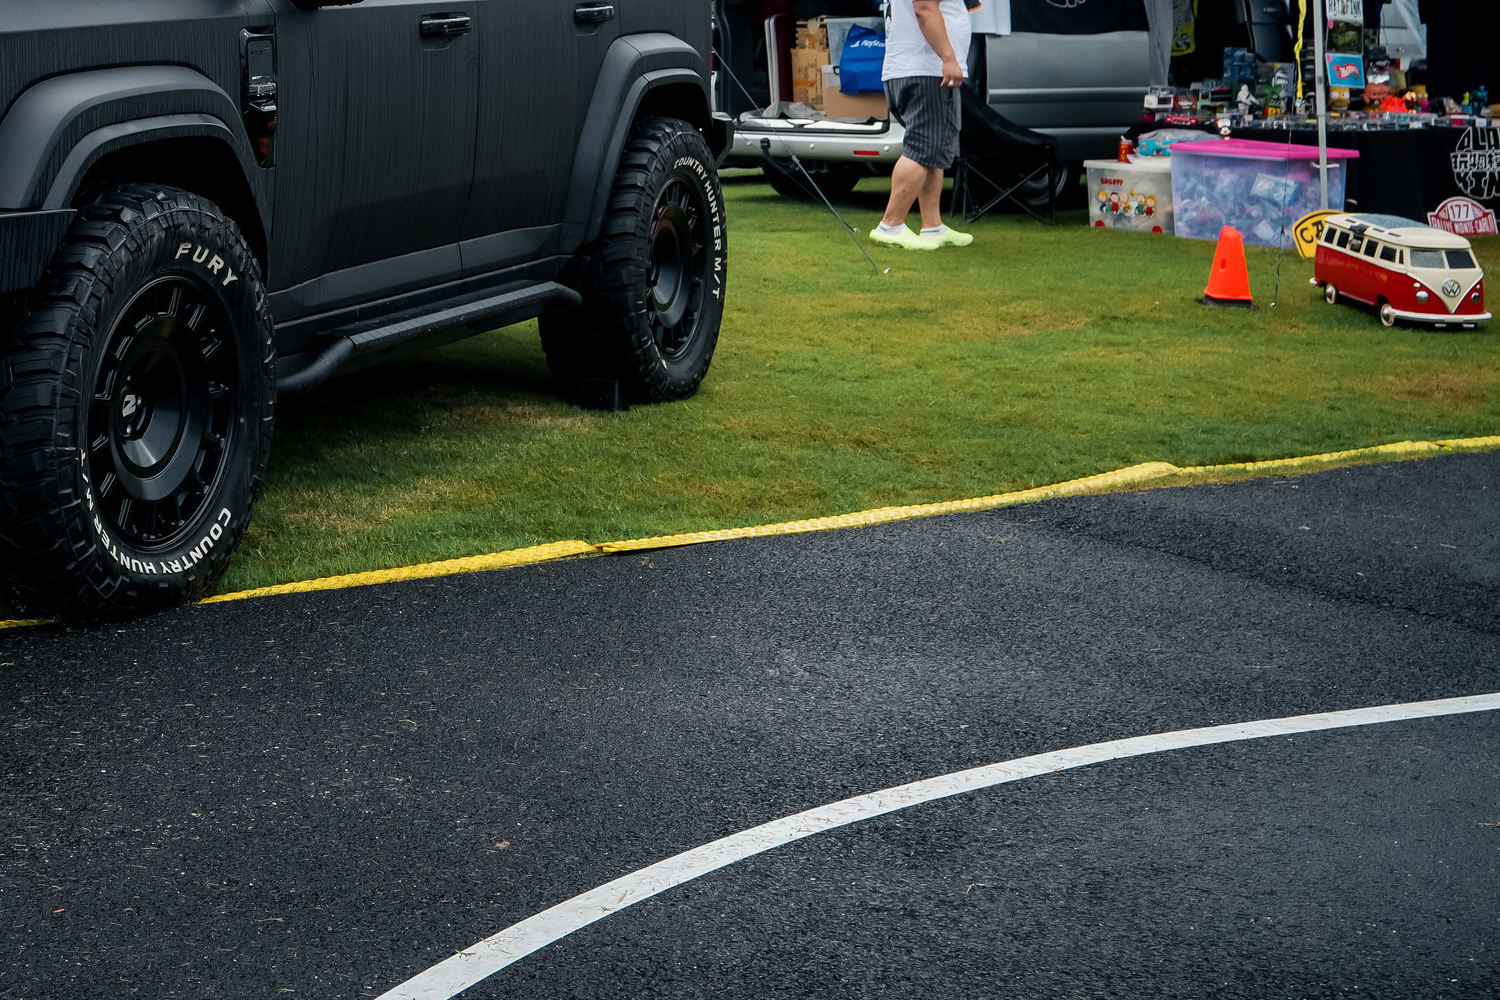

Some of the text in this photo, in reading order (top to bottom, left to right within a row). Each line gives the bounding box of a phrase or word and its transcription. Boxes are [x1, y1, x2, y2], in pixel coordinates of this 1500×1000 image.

[673, 156, 722, 299] COUNTRY HUNTER M/T
[1300, 220, 1325, 243] CA
[1450, 204, 1470, 219] 177
[174, 242, 239, 287] FURY
[94, 513, 157, 574] HUNTER
[161, 507, 233, 574] COUNTRY
